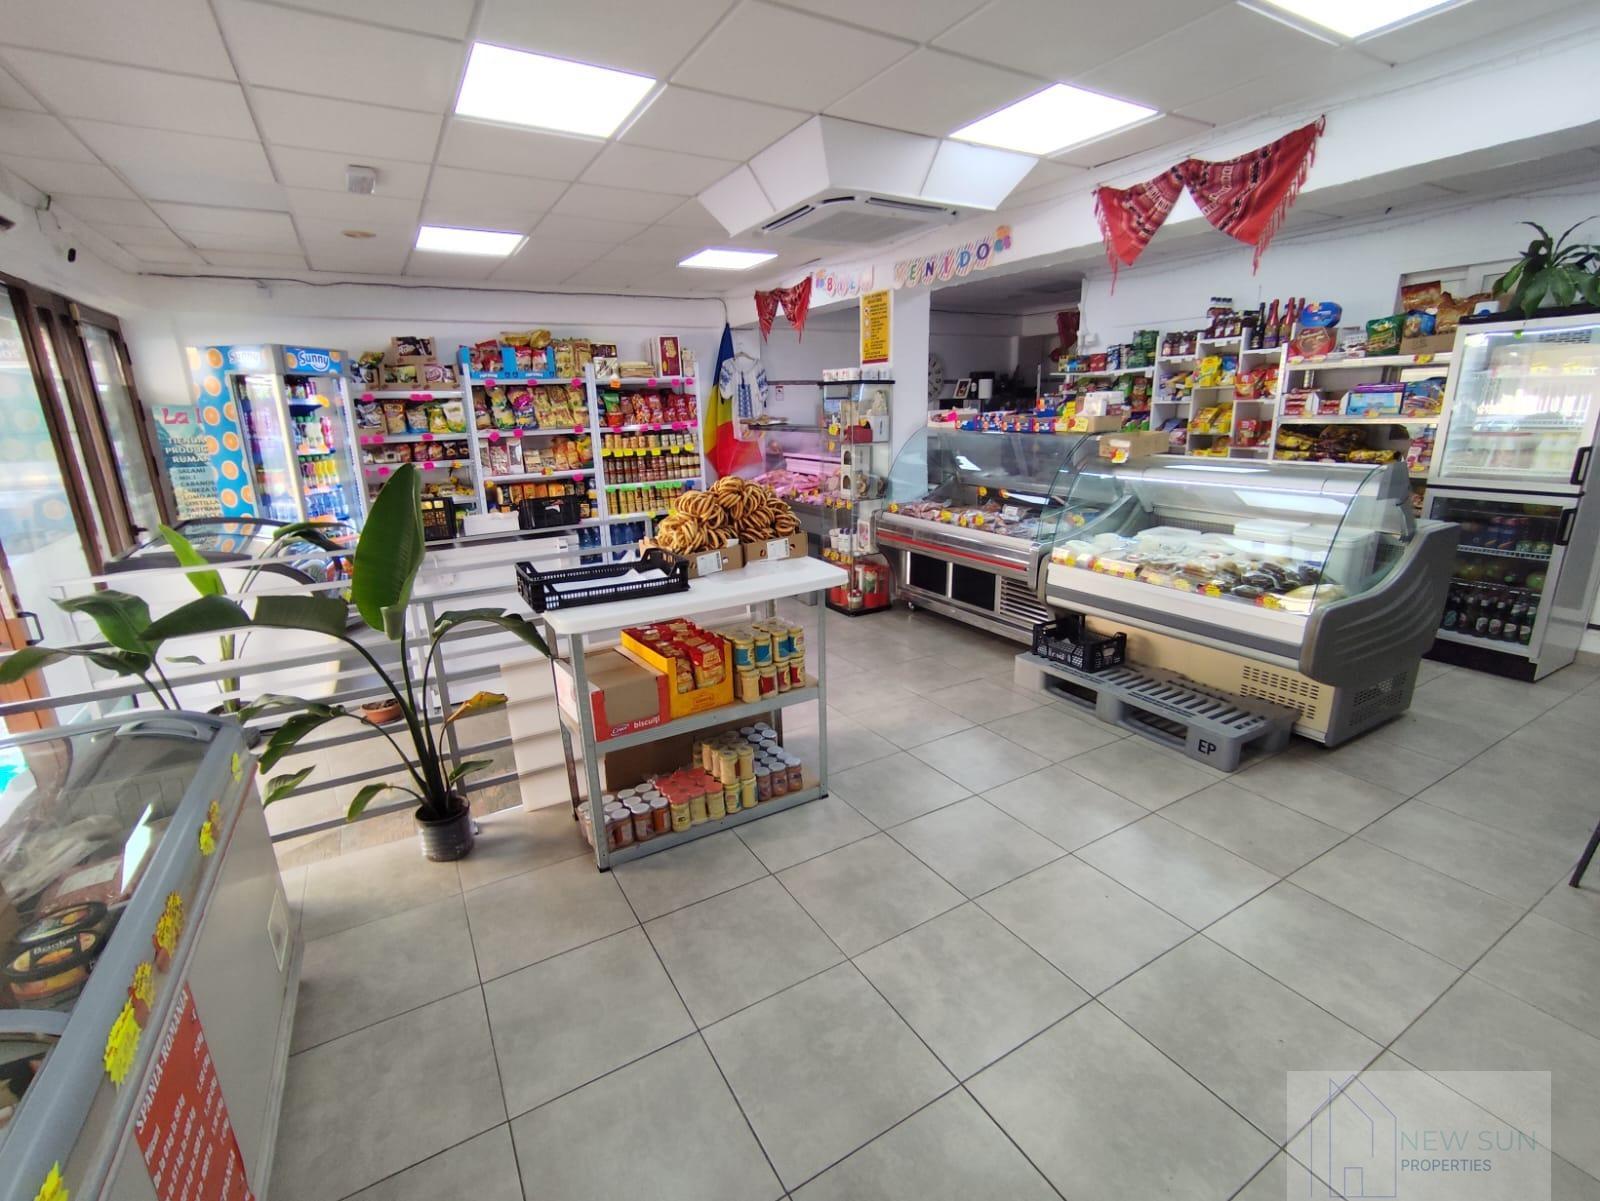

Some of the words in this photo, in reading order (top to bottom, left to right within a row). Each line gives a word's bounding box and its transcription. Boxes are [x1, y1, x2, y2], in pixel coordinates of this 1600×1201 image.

[298, 350, 330, 368] Sunny
[161, 407, 189, 424] La
[1198, 740, 1216, 755] EP
